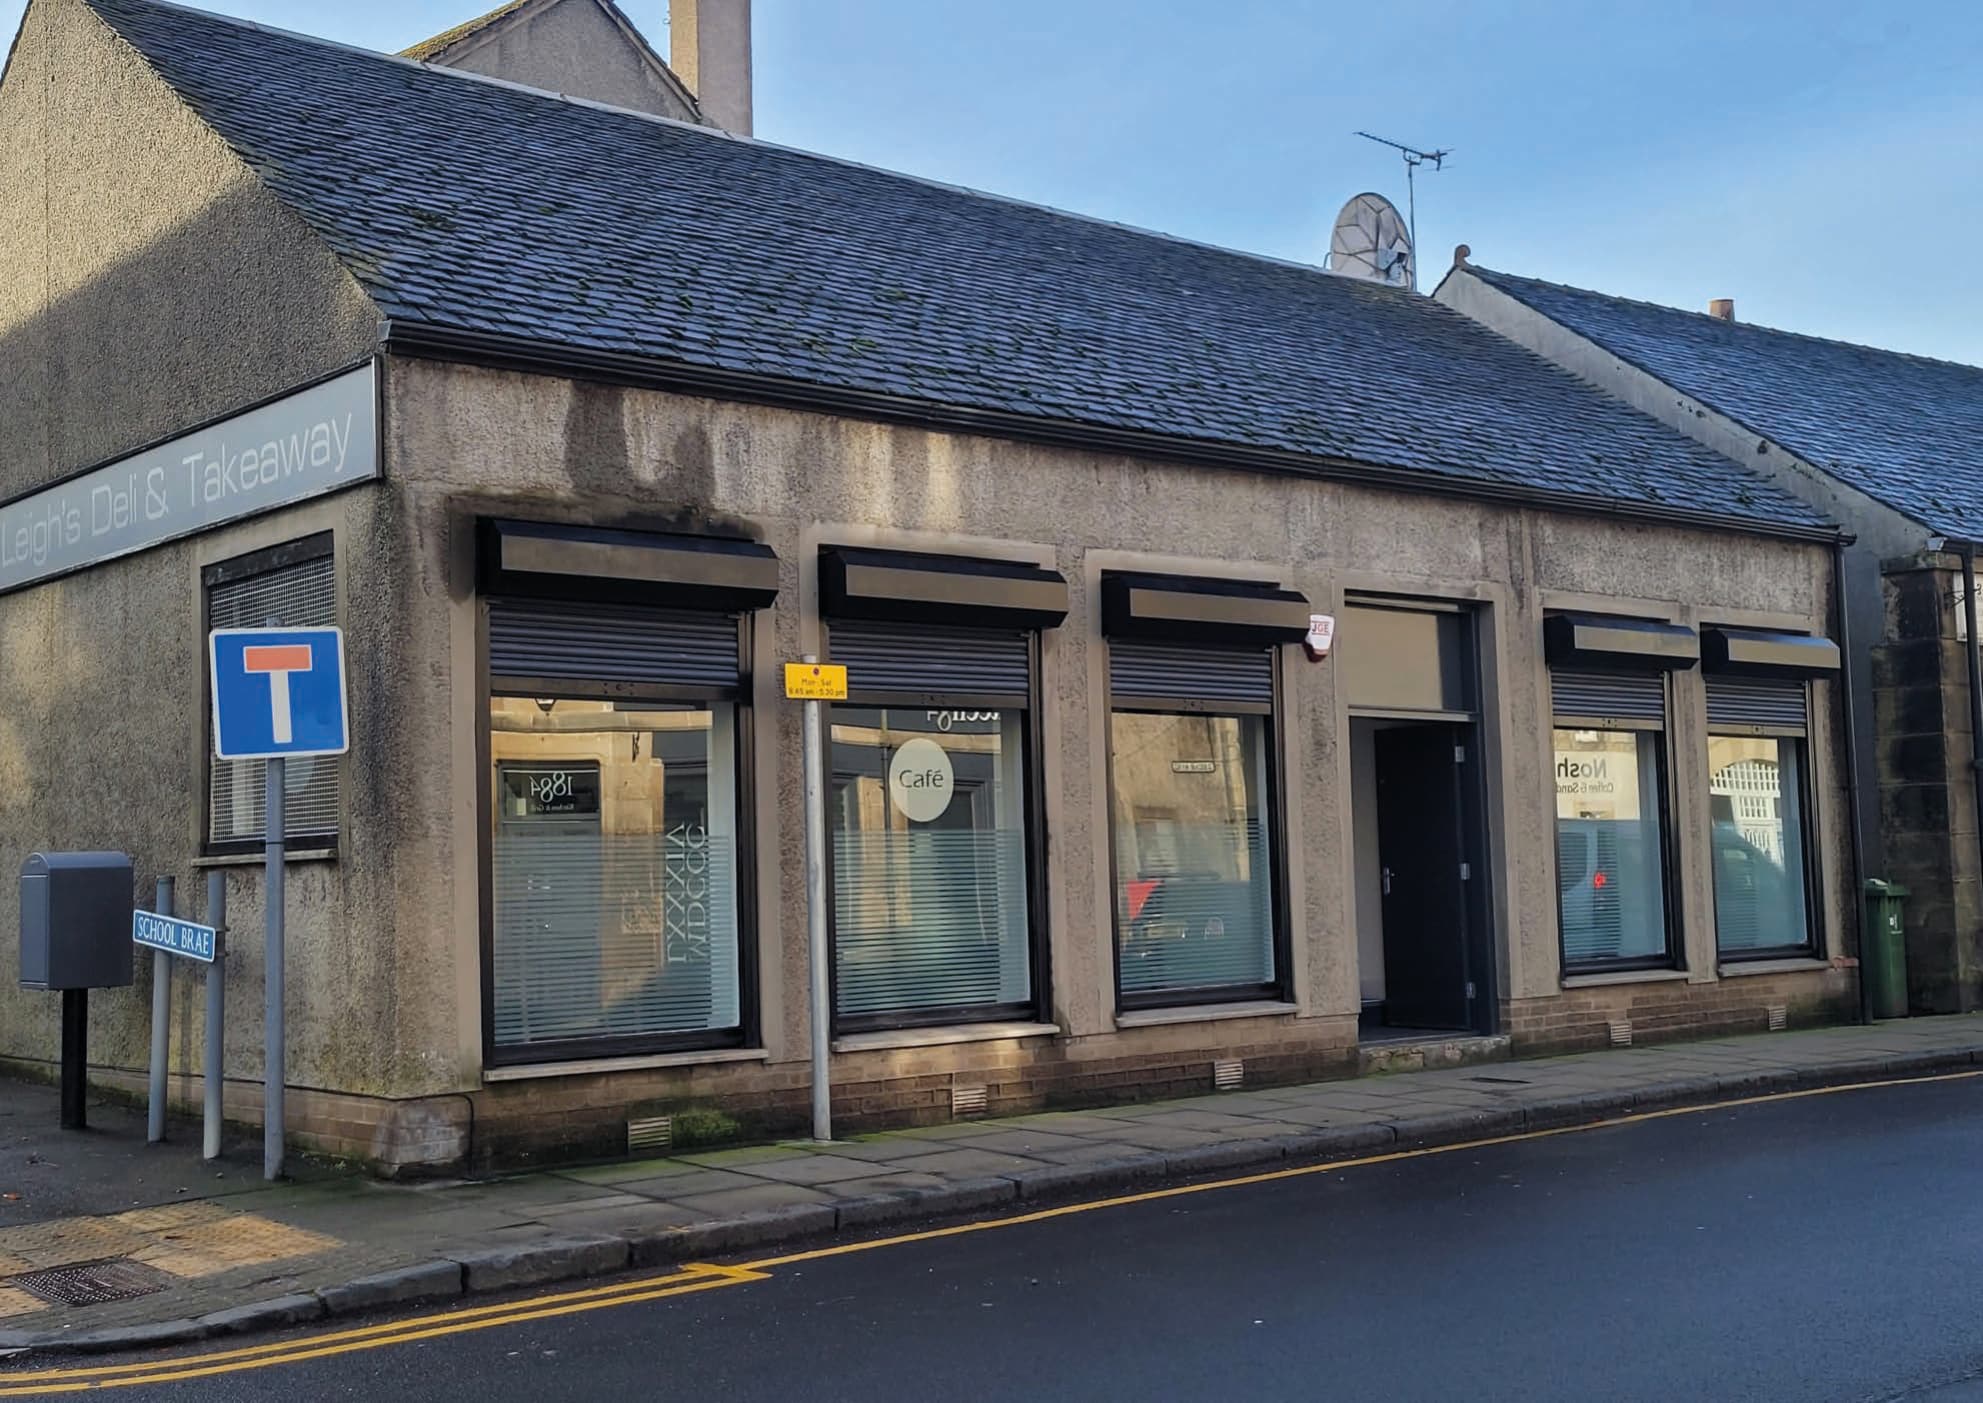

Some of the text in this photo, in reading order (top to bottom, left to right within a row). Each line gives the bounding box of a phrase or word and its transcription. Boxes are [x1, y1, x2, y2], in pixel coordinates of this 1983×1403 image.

[1, 412, 352, 567] Leigh's Deli & Takeaway
[899, 768, 944, 789] Café
[138, 916, 209, 954] SCHOOL BRAE
